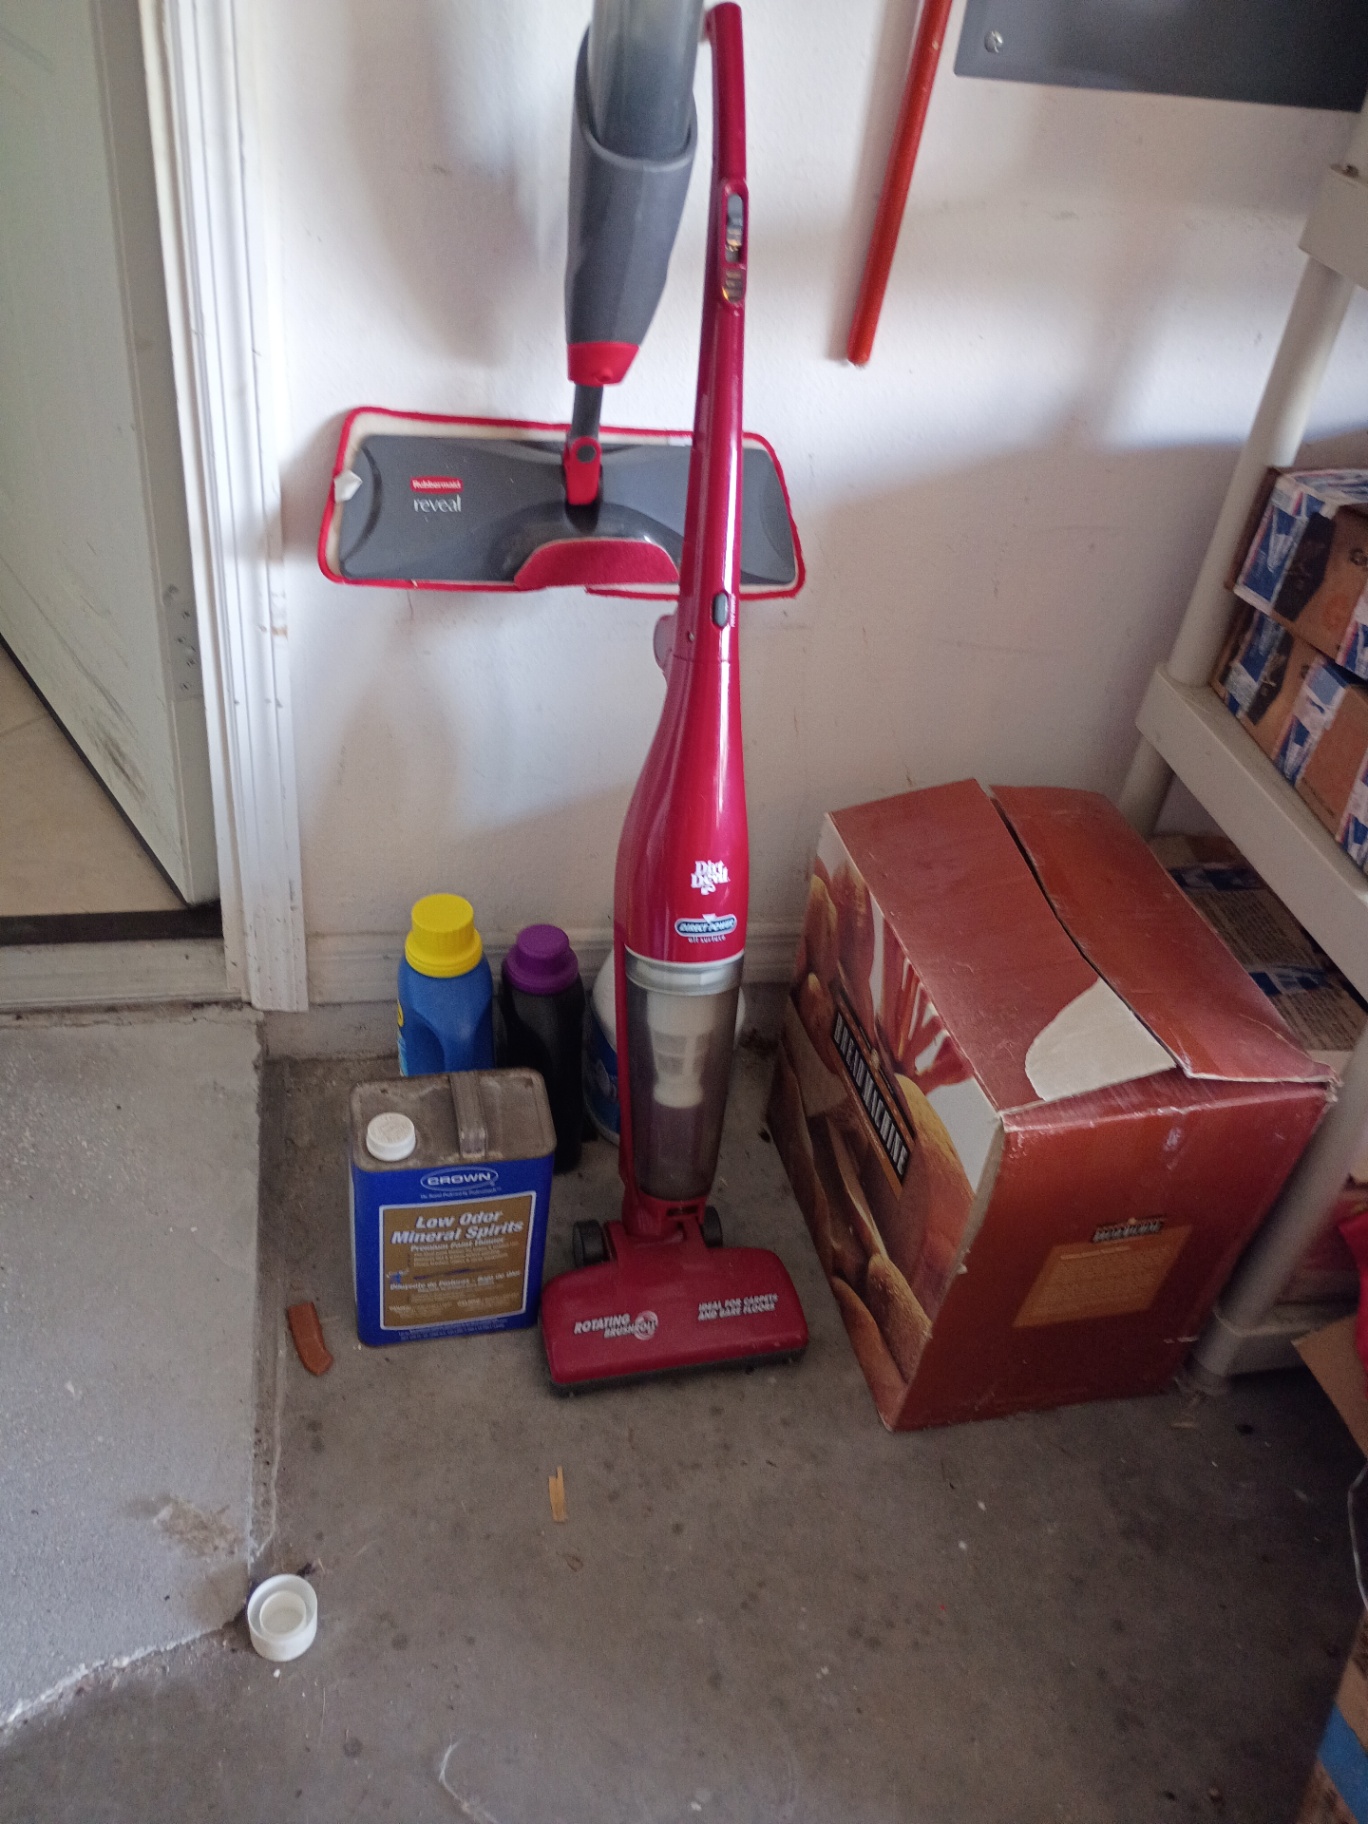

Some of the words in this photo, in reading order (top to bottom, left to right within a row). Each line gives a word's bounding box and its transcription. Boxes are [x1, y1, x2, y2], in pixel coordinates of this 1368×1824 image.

[412, 479, 462, 489] Rubbermaid
[413, 494, 462, 513] reveal
[427, 1172, 491, 1186] CROWN
[415, 1216, 455, 1229] Low
[459, 1211, 504, 1226] Odor
[391, 1228, 462, 1245] Mineral
[465, 1221, 525, 1240] Spirits
[698, 1301, 721, 1312] IDEAL
[724, 1298, 742, 1308] FOR
[743, 1293, 778, 1305] CARPETS
[573, 1313, 631, 1335] ROTATING
[698, 1310, 718, 1321] AND
